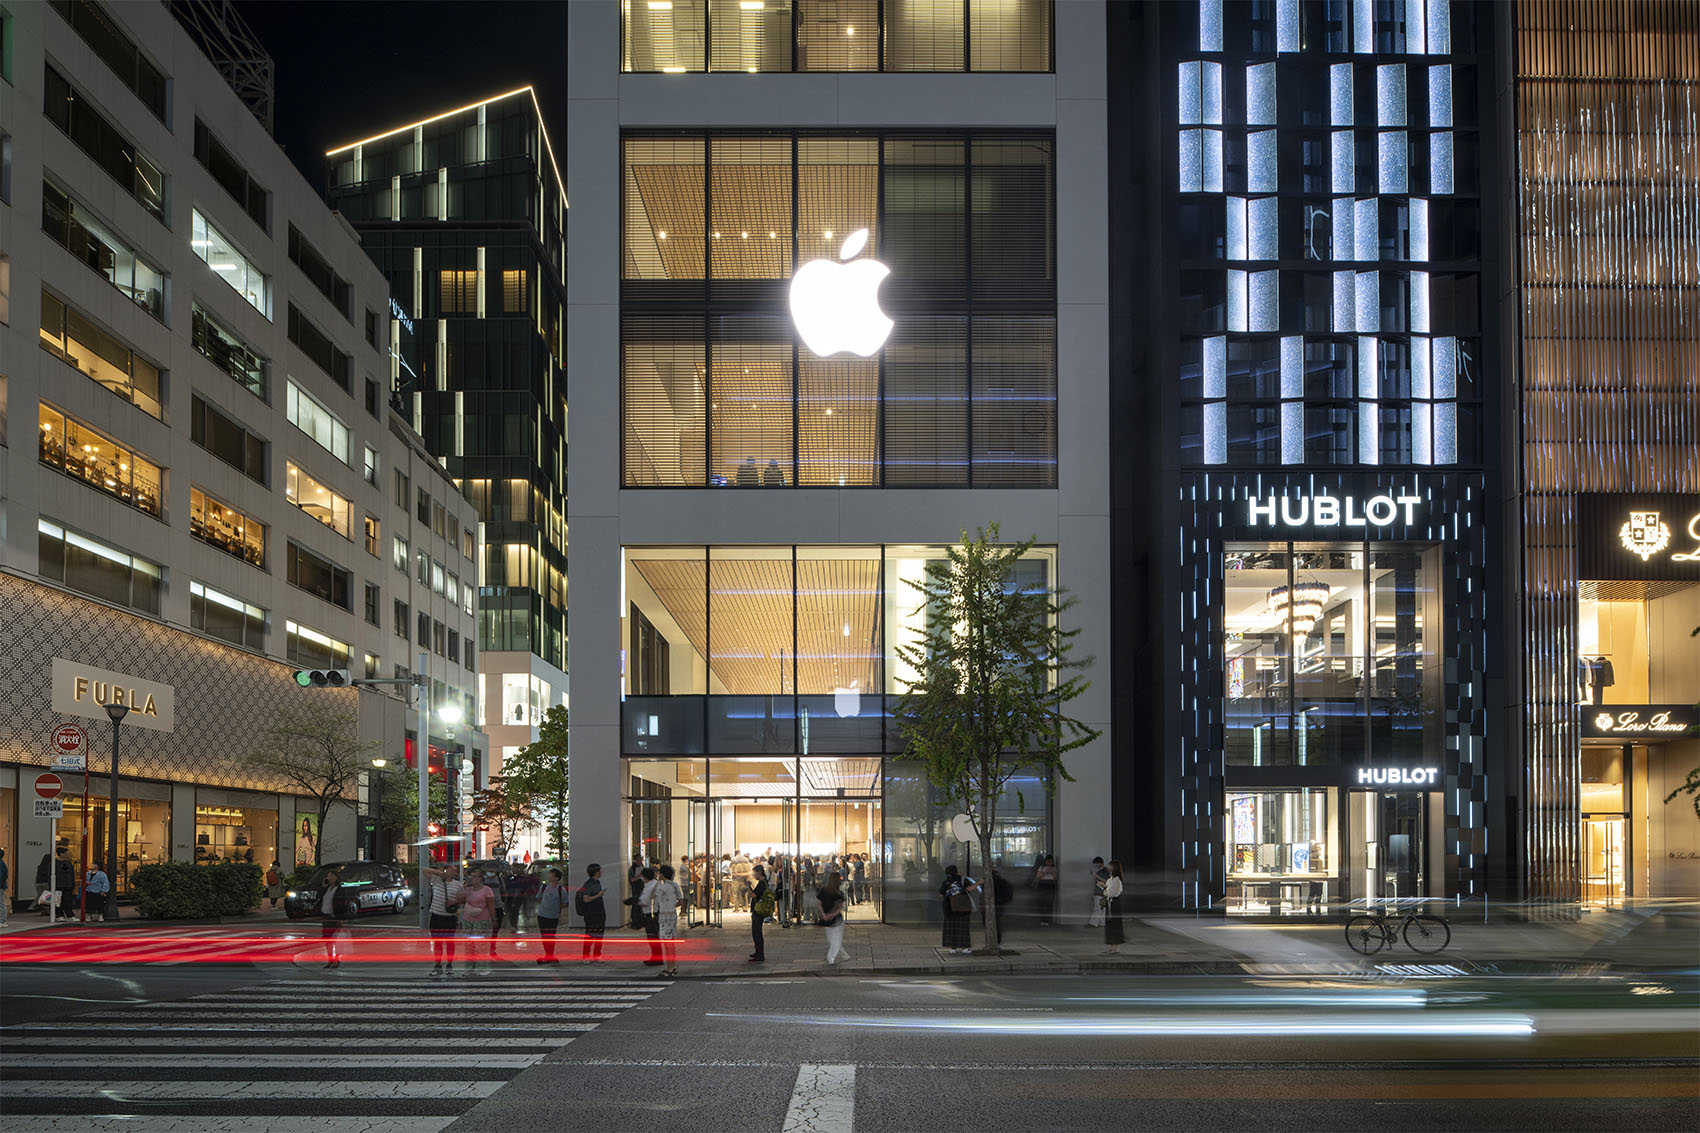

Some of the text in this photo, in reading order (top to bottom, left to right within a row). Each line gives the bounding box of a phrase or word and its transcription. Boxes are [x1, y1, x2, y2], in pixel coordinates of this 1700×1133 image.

[1249, 495, 1421, 526] HUBLOT
[74, 676, 157, 718] FURLA
[1612, 711, 1687, 731] Loro Piana
[58, 734, 80, 745] 消火栓
[1358, 767, 1438, 784] HUBLOT
